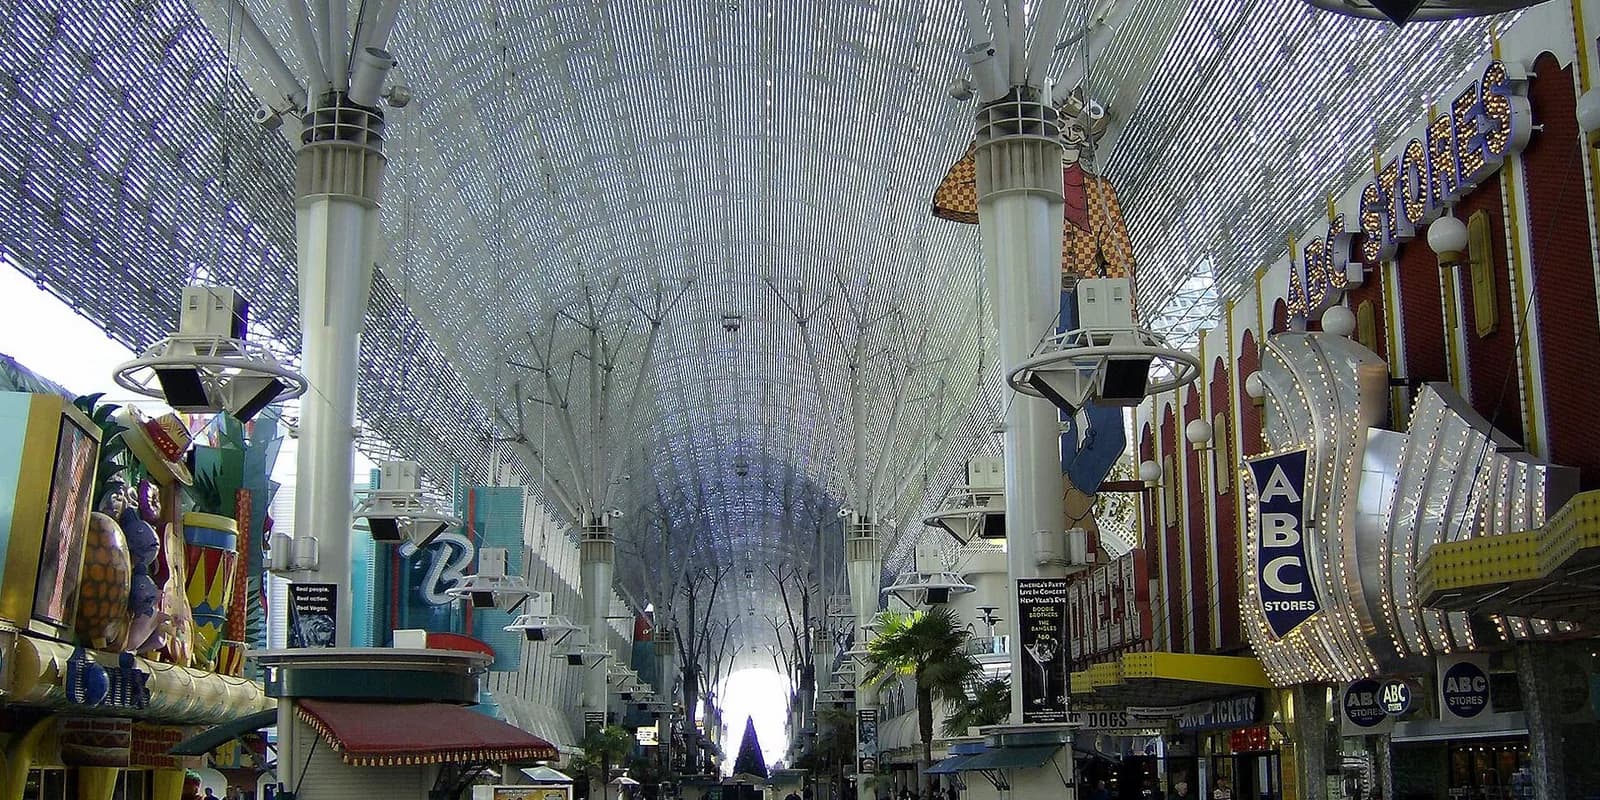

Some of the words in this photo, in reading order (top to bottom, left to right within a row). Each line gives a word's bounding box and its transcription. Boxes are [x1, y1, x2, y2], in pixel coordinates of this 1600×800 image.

[1286, 213, 1351, 332] ABC
[1360, 60, 1512, 262] STORES
[1259, 463, 1303, 594] ABC
[1264, 600, 1316, 612] STORES
[1447, 676, 1486, 693] ABC
[1347, 692, 1378, 707] AB
[1383, 683, 1406, 703] ABC
[1449, 696, 1483, 705] STORES
[1210, 696, 1257, 724] TICKETS
[1351, 708, 1384, 718] STORES
[1388, 703, 1402, 711] STORES
[1088, 712, 1128, 727] DOGS
